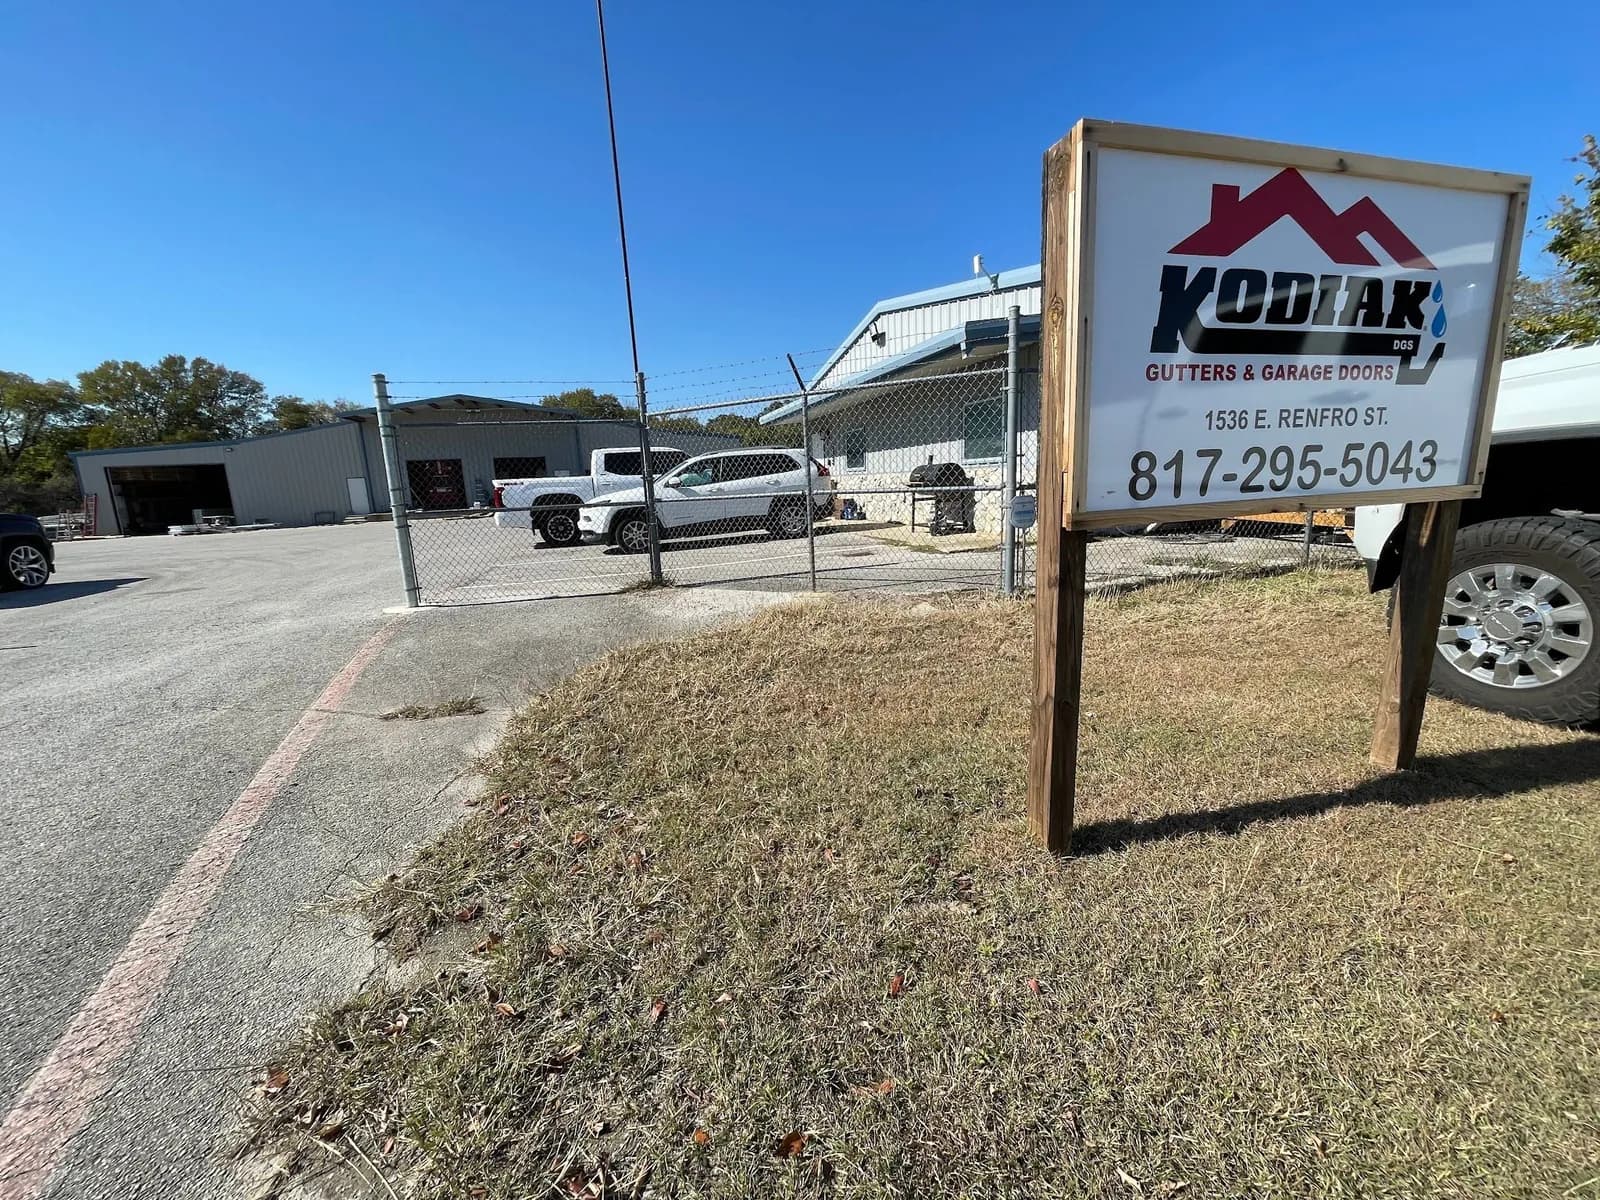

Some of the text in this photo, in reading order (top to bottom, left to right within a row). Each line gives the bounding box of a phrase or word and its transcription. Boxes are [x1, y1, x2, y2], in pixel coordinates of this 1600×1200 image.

[1149, 264, 1432, 355] KODIAK
[1393, 340, 1414, 351] DGS
[1145, 363, 1394, 382] GUTTERS & GARAGE DOORS
[1205, 406, 1389, 430] 1536 E. RENFRO ST.
[1128, 440, 1439, 501] 817-295-5043
